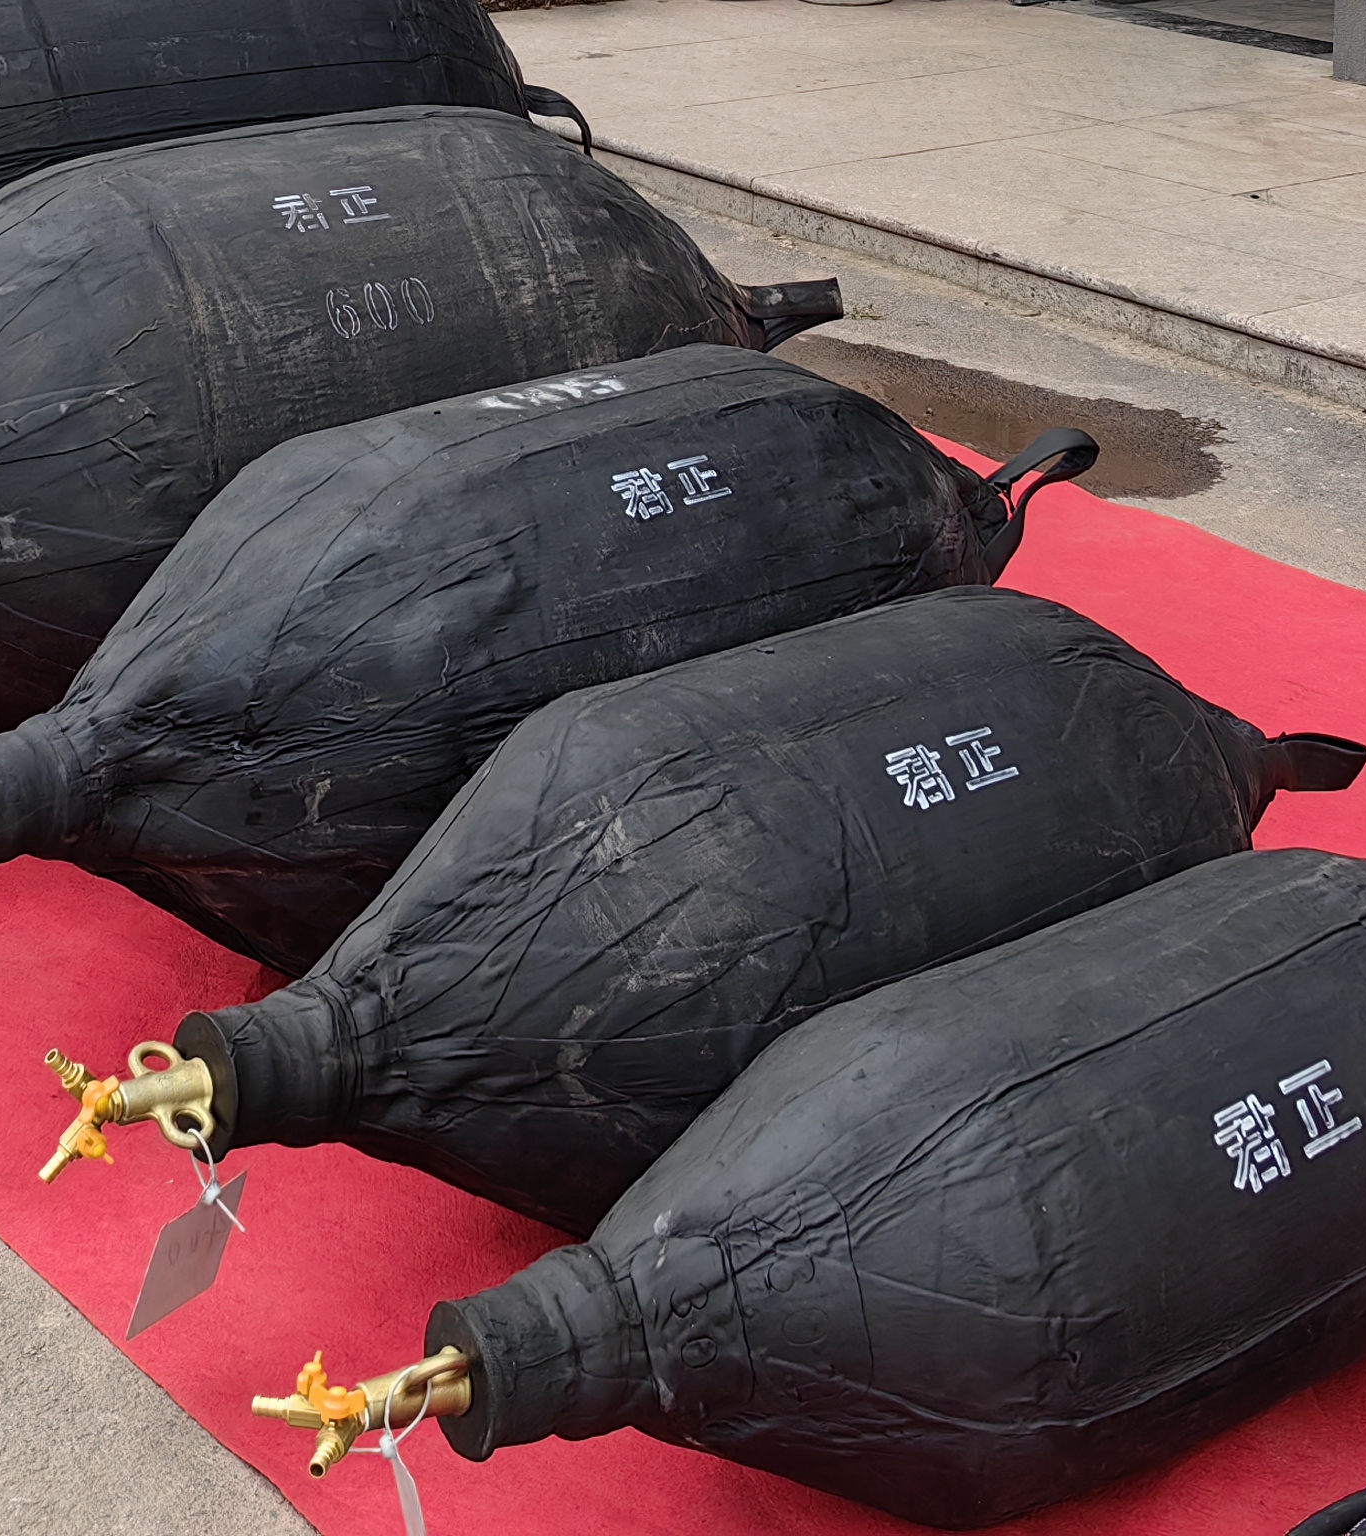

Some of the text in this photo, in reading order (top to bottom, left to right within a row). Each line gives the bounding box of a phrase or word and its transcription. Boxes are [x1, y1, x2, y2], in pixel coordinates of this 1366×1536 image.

[271, 185, 392, 233] 君正
[325, 277, 436, 339] 600
[610, 454, 733, 520] 君正
[885, 726, 1020, 810] 君正
[1213, 1059, 1363, 1194] 君正
